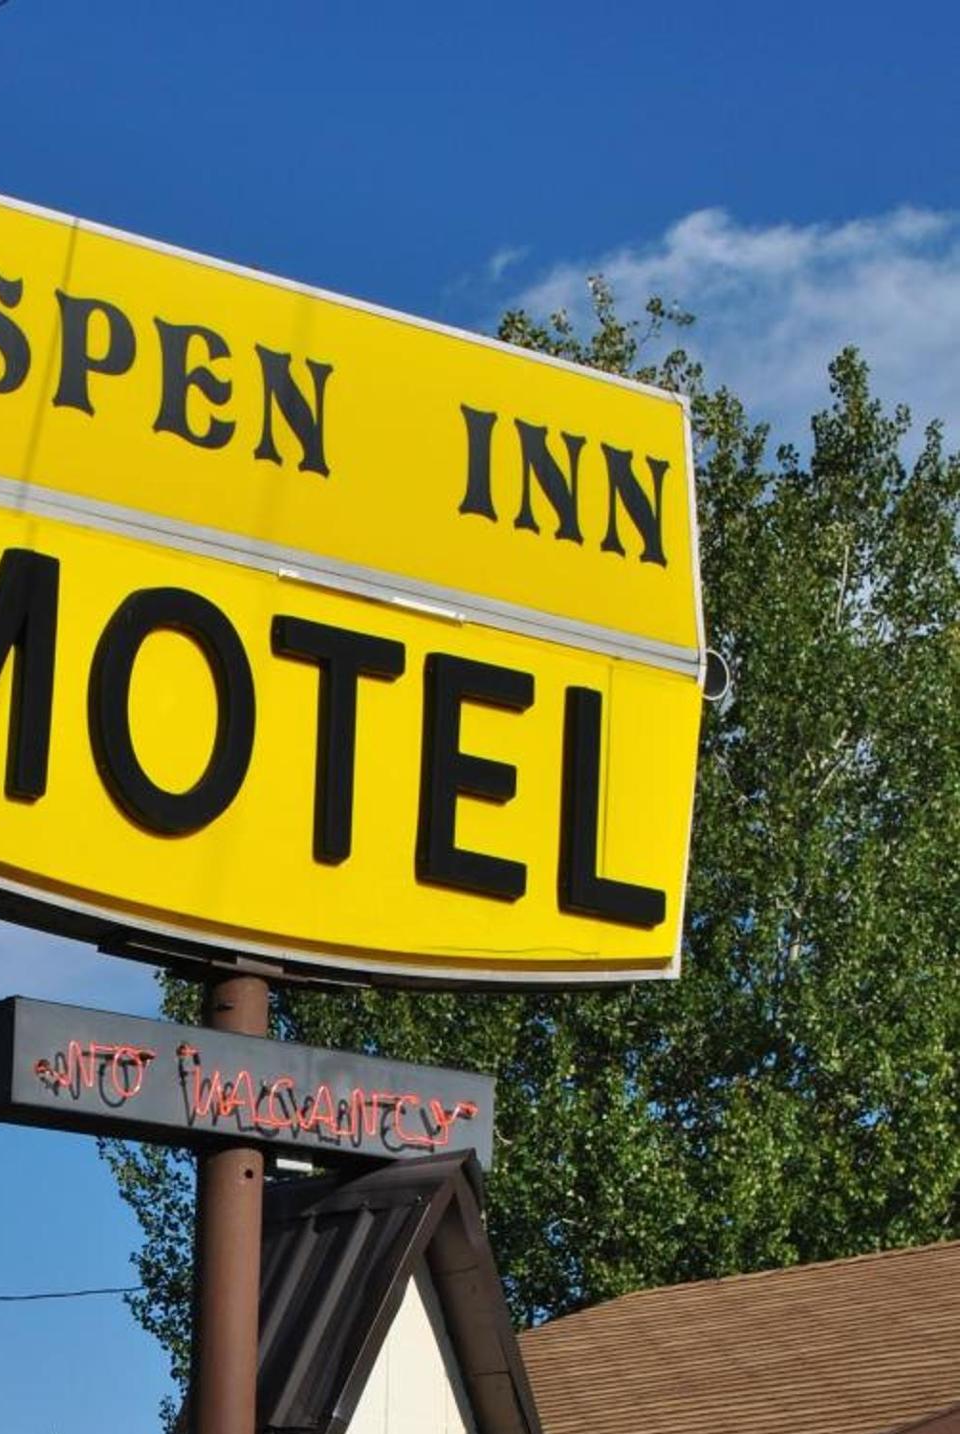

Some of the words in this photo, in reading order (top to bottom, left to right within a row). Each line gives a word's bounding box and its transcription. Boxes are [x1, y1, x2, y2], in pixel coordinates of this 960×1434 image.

[457, 403, 670, 568] INN
[42, 1040, 155, 1096] NO
[182, 1050, 476, 1145] VACANCY
